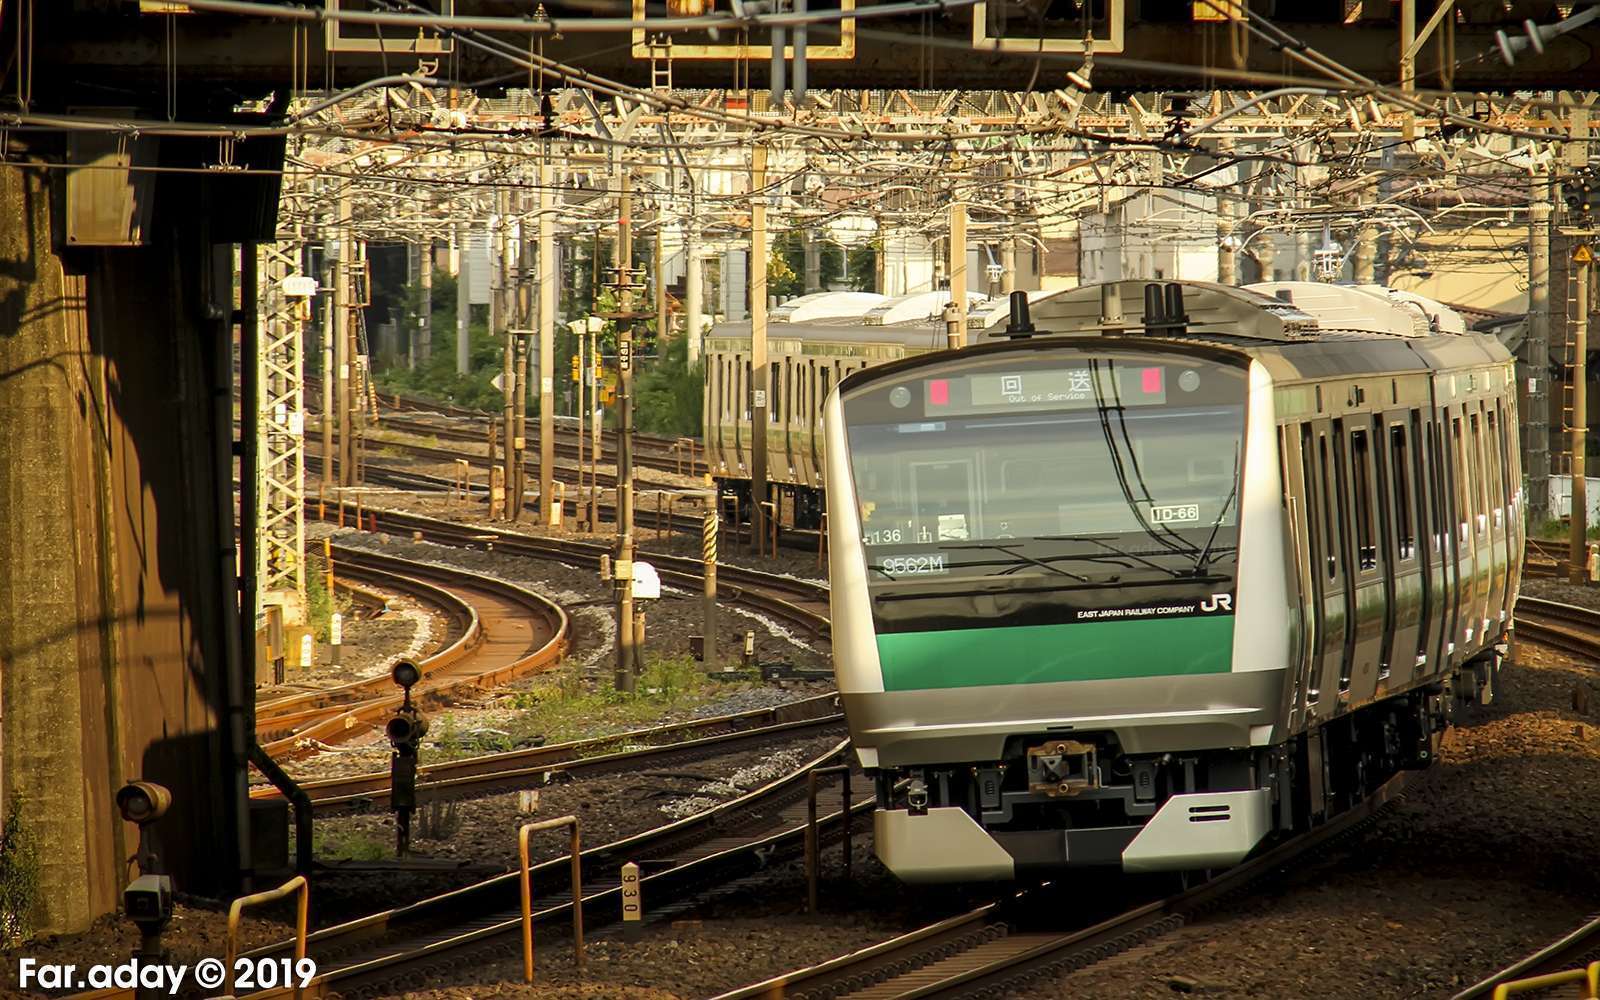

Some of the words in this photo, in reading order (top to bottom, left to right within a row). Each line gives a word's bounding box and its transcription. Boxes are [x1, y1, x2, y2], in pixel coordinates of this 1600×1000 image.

[1000, 370, 1091, 395] 回送
[1008, 395, 1026, 403] Out
[1031, 394, 1041, 402] of
[1047, 392, 1086, 401] Service
[882, 555, 944, 574] 9562M
[1077, 610, 1098, 619] EAST
[1098, 609, 1124, 618] JAPAN
[1125, 607, 1156, 616] RAILWAY
[1157, 605, 1195, 615] COMPANY
[1201, 593, 1232, 612] JR
[623, 874, 638, 912] 930
